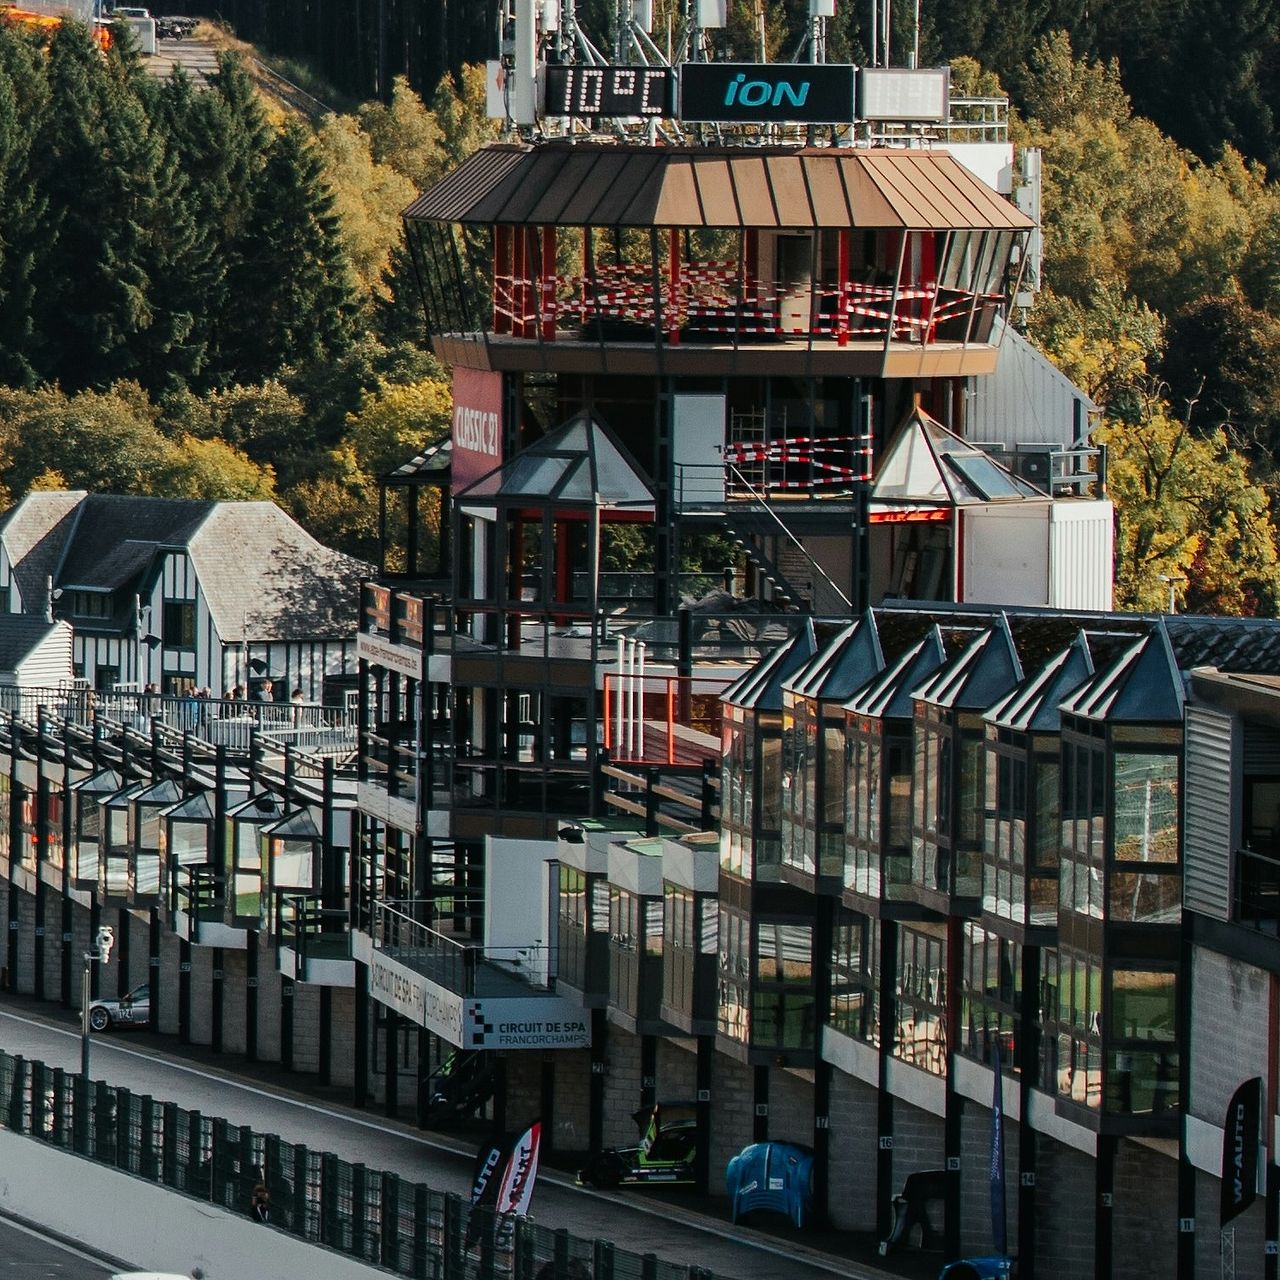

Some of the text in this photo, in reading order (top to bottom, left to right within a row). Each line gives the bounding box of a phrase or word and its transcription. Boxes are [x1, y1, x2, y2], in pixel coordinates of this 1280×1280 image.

[456, 406, 498, 457] CLASSIC 21
[499, 1022, 587, 1033] CIRCUIT DE SPA
[499, 1034, 587, 1045] FRANCORCHAMPS
[881, 1137, 892, 1148] 16
[1234, 1104, 1245, 1204] W-AUTO
[949, 1159, 959, 1169] 15
[1023, 1174, 1034, 1184] 14
